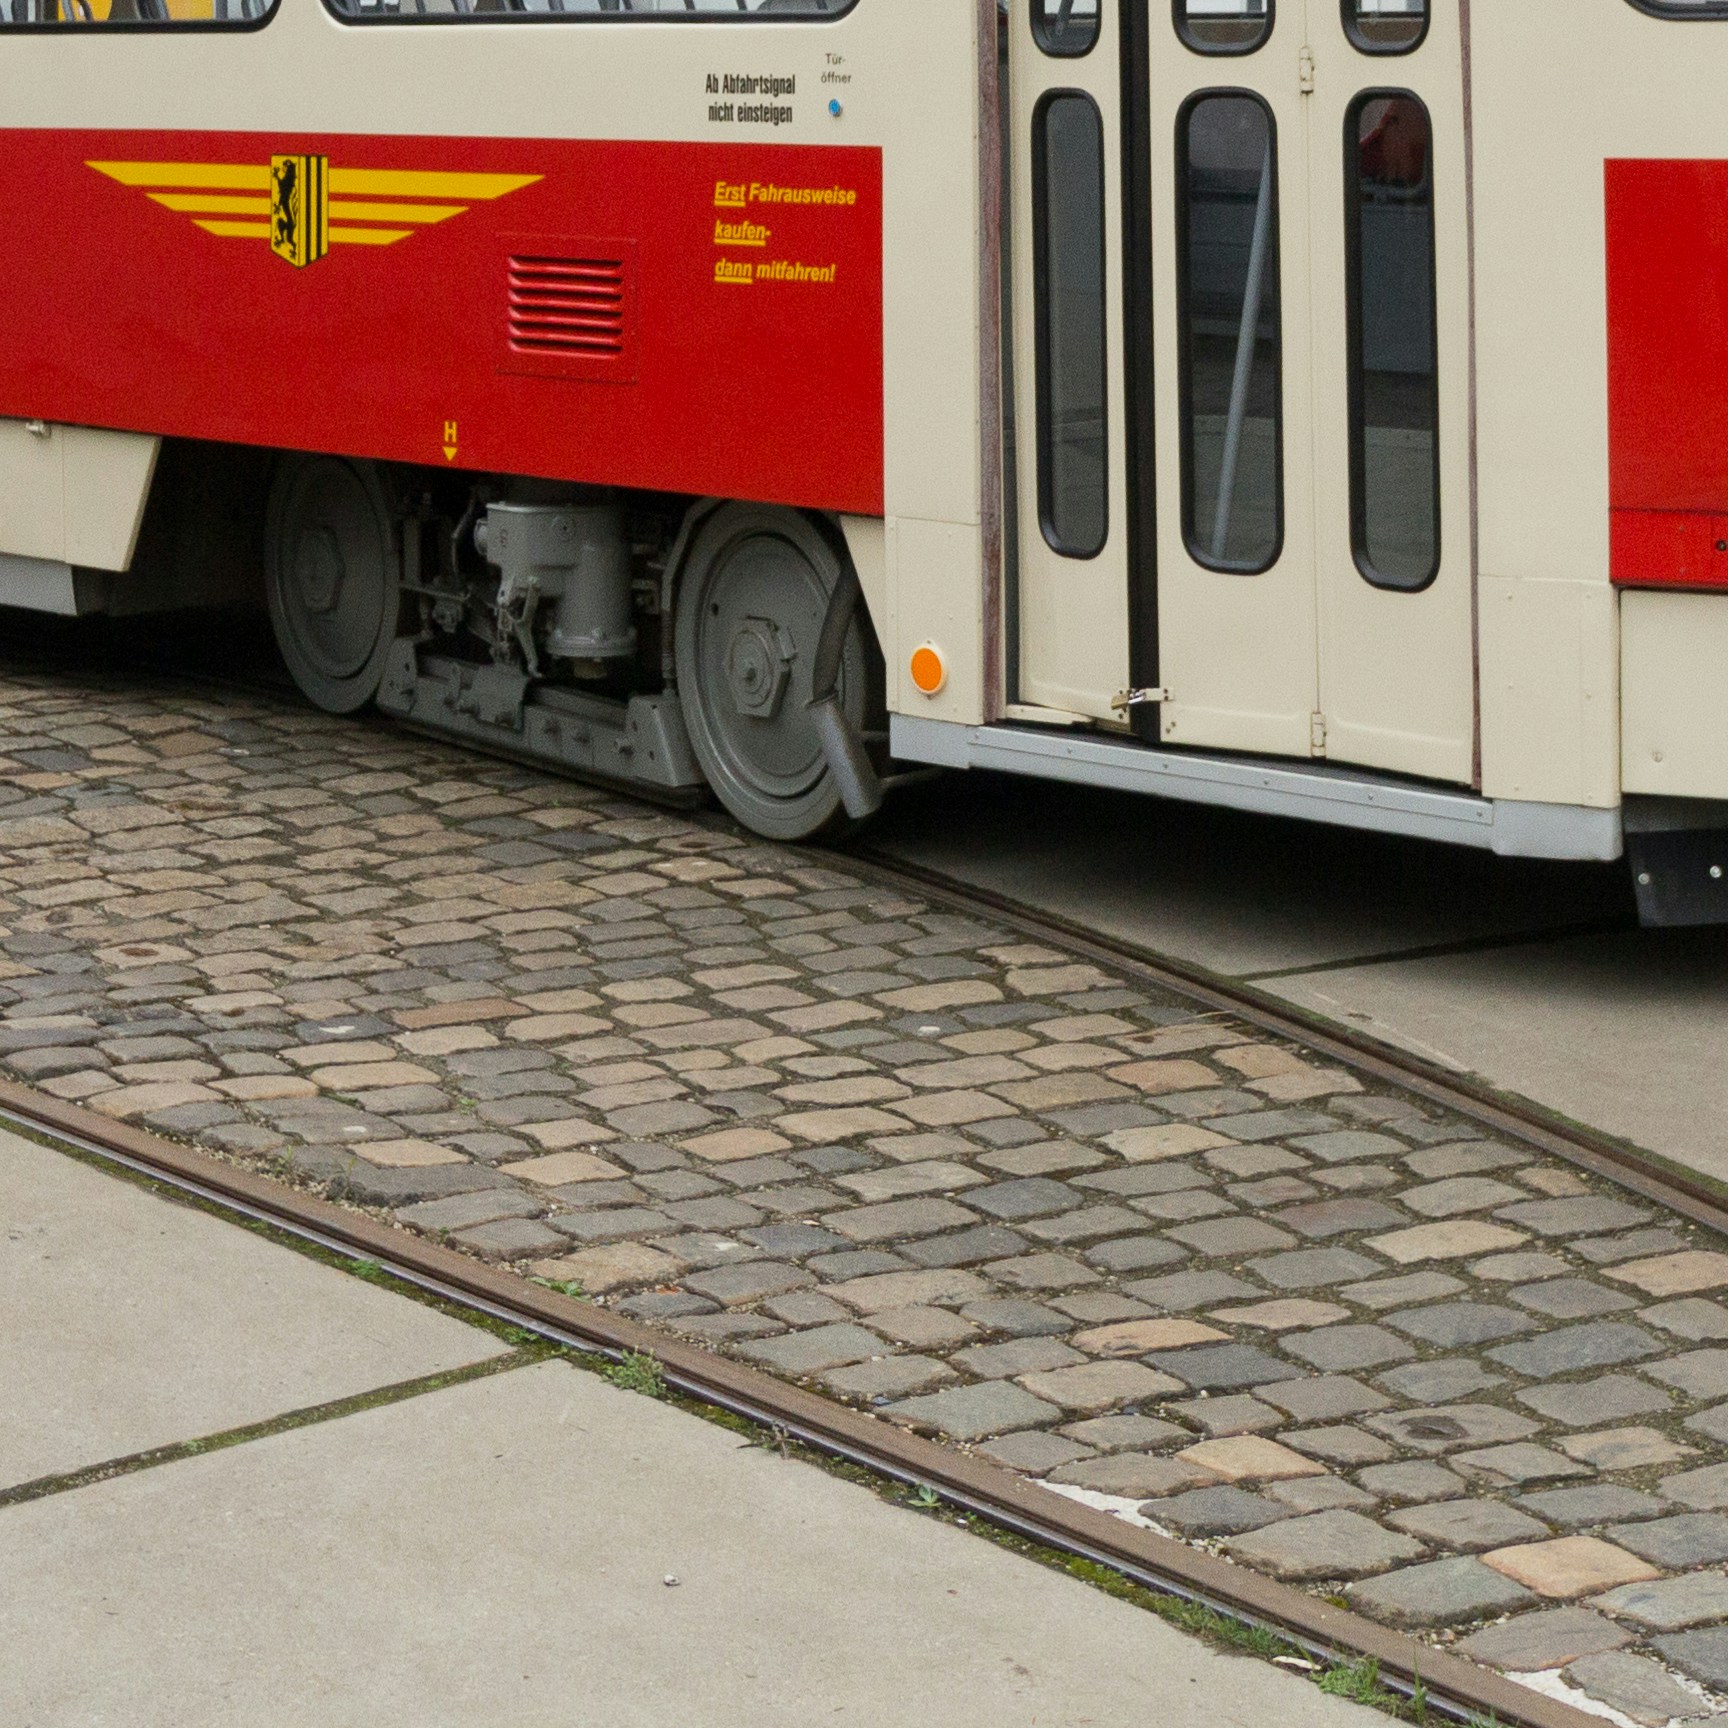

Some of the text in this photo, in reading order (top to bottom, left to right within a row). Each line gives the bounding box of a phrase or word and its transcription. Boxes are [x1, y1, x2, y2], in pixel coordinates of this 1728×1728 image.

[825, 53, 845, 65] Tür-
[705, 73, 796, 97] Ab Abfahrtsignal
[820, 71, 852, 84] öffner
[708, 102, 793, 126] nicht einsteigen
[715, 181, 856, 205] Erst Fahrausweise
[715, 220, 771, 243] kaufen-
[715, 258, 836, 283] dann mitfahren!
[444, 421, 457, 443] H
